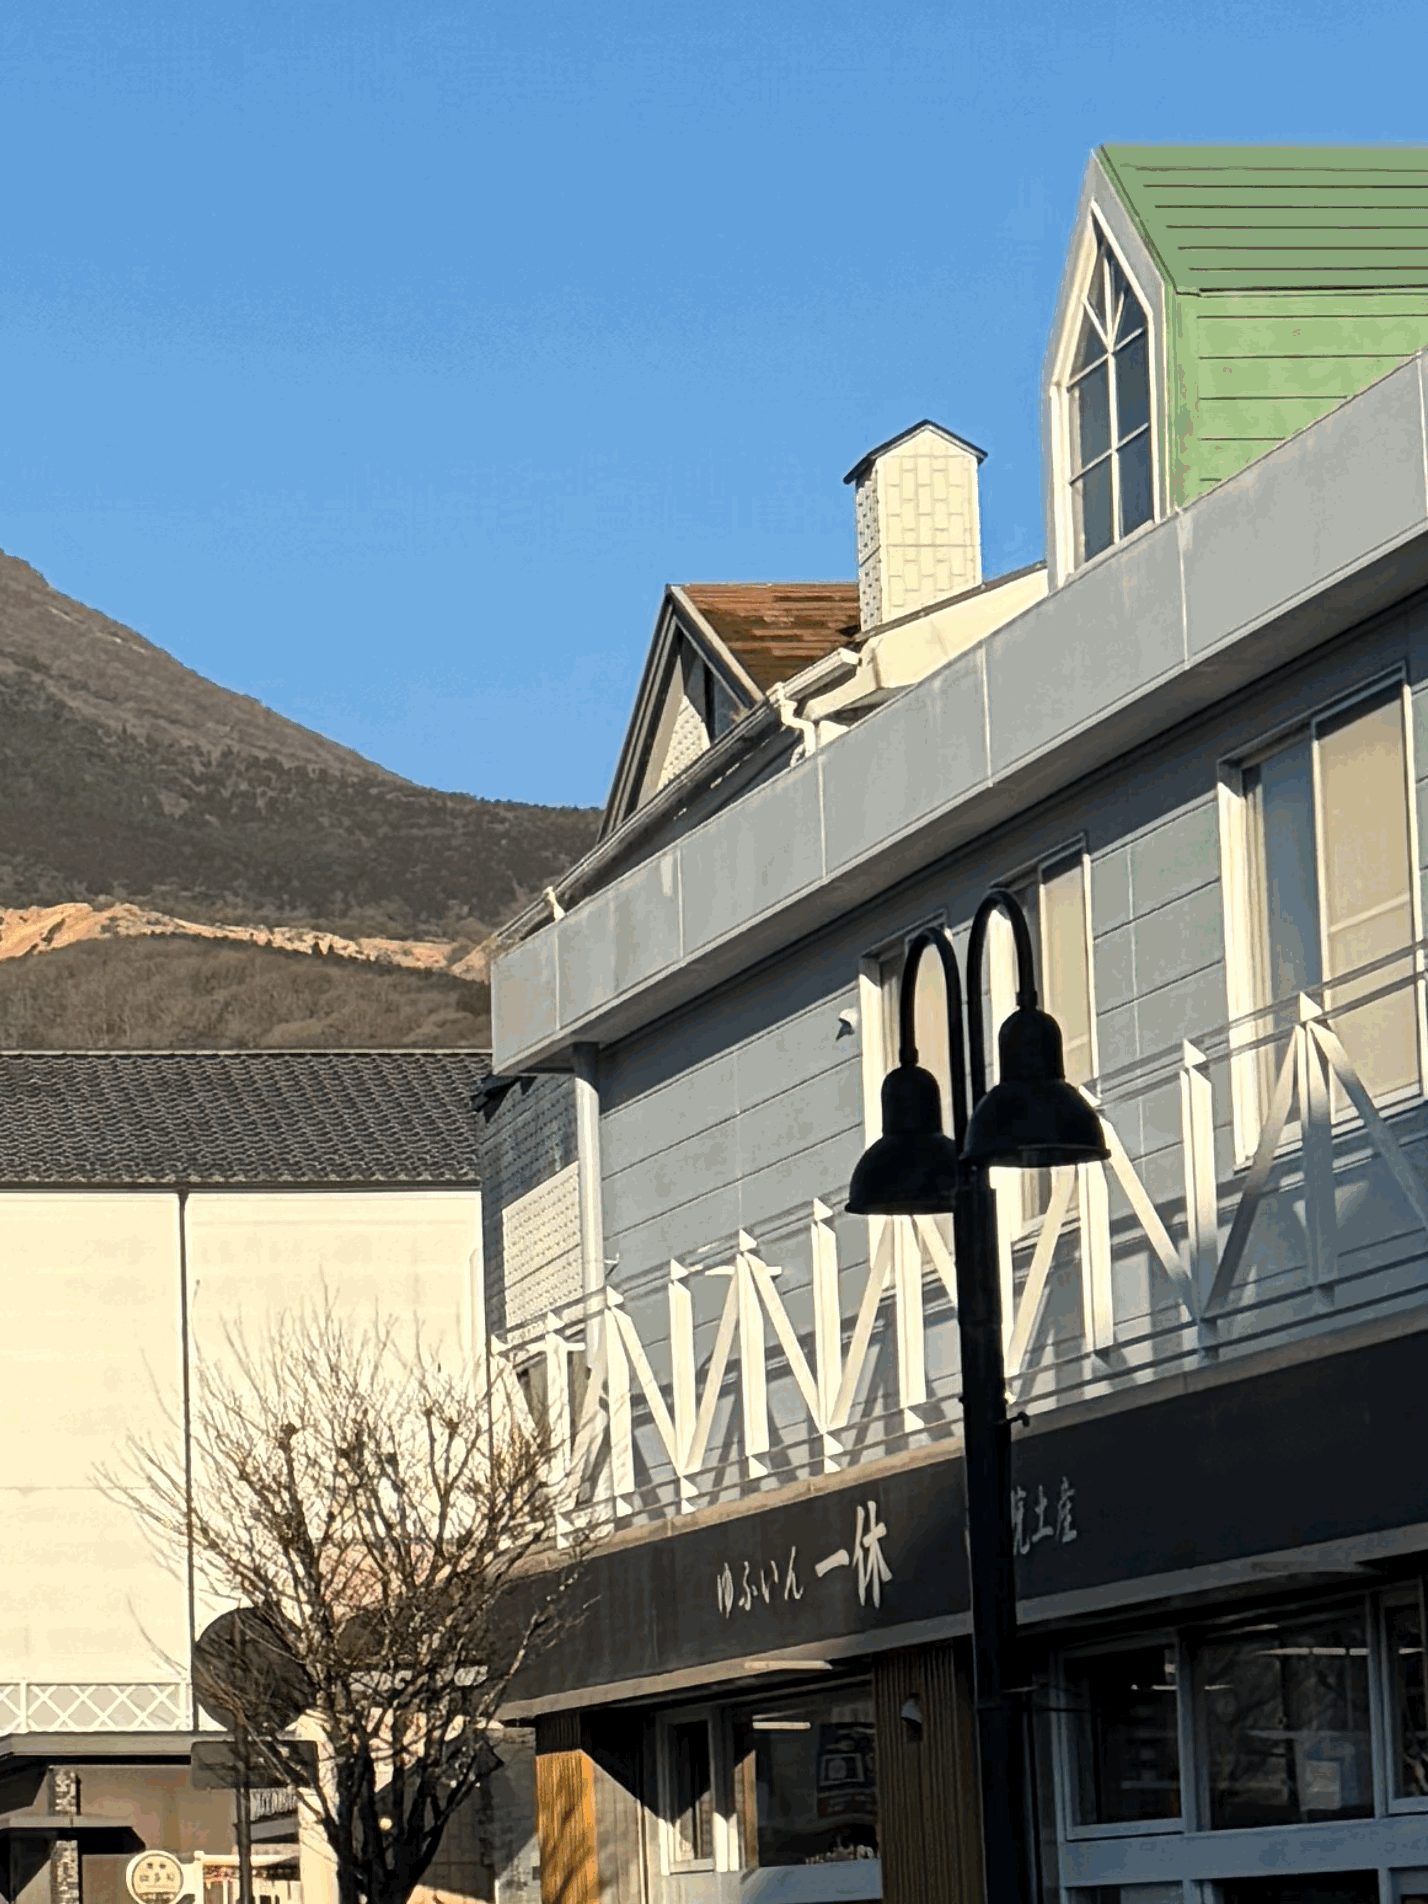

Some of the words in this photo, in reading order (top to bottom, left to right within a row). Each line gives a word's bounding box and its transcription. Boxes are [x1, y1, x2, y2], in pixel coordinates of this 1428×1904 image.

[716, 1545, 804, 1620] ゆふいん
[814, 1500, 894, 1609] 一休
